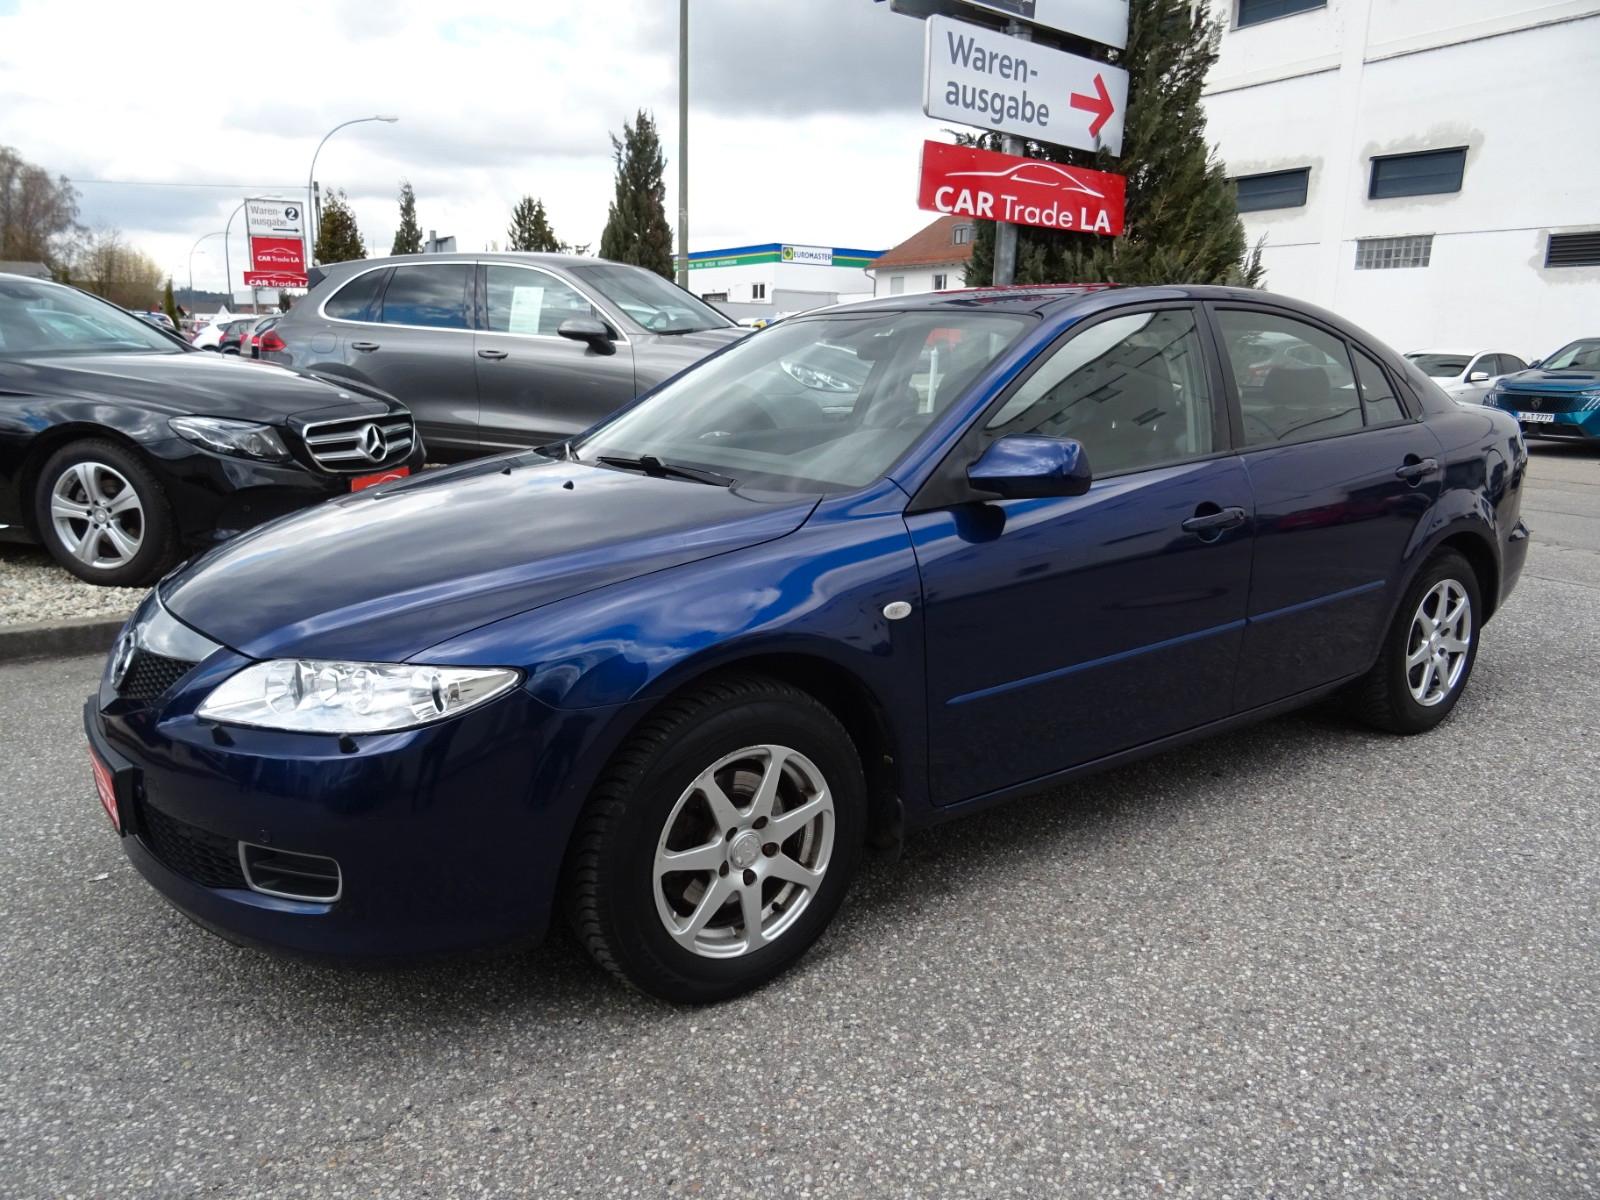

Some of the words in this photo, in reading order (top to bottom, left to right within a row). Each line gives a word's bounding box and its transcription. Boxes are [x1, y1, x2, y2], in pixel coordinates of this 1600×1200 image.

[947, 31, 1038, 83] Waren-
[945, 80, 1050, 127] ausgabe
[250, 205, 282, 216] Waren-
[934, 186, 994, 218] CAR
[1001, 194, 1073, 228] Trade
[1080, 207, 1111, 232] LA
[251, 217, 287, 228] ausgabe
[793, 251, 832, 261] EUROMASTER
[249, 279, 269, 287] CAR
[271, 280, 297, 288] Trade
[1536, 413, 1553, 421] 7777
